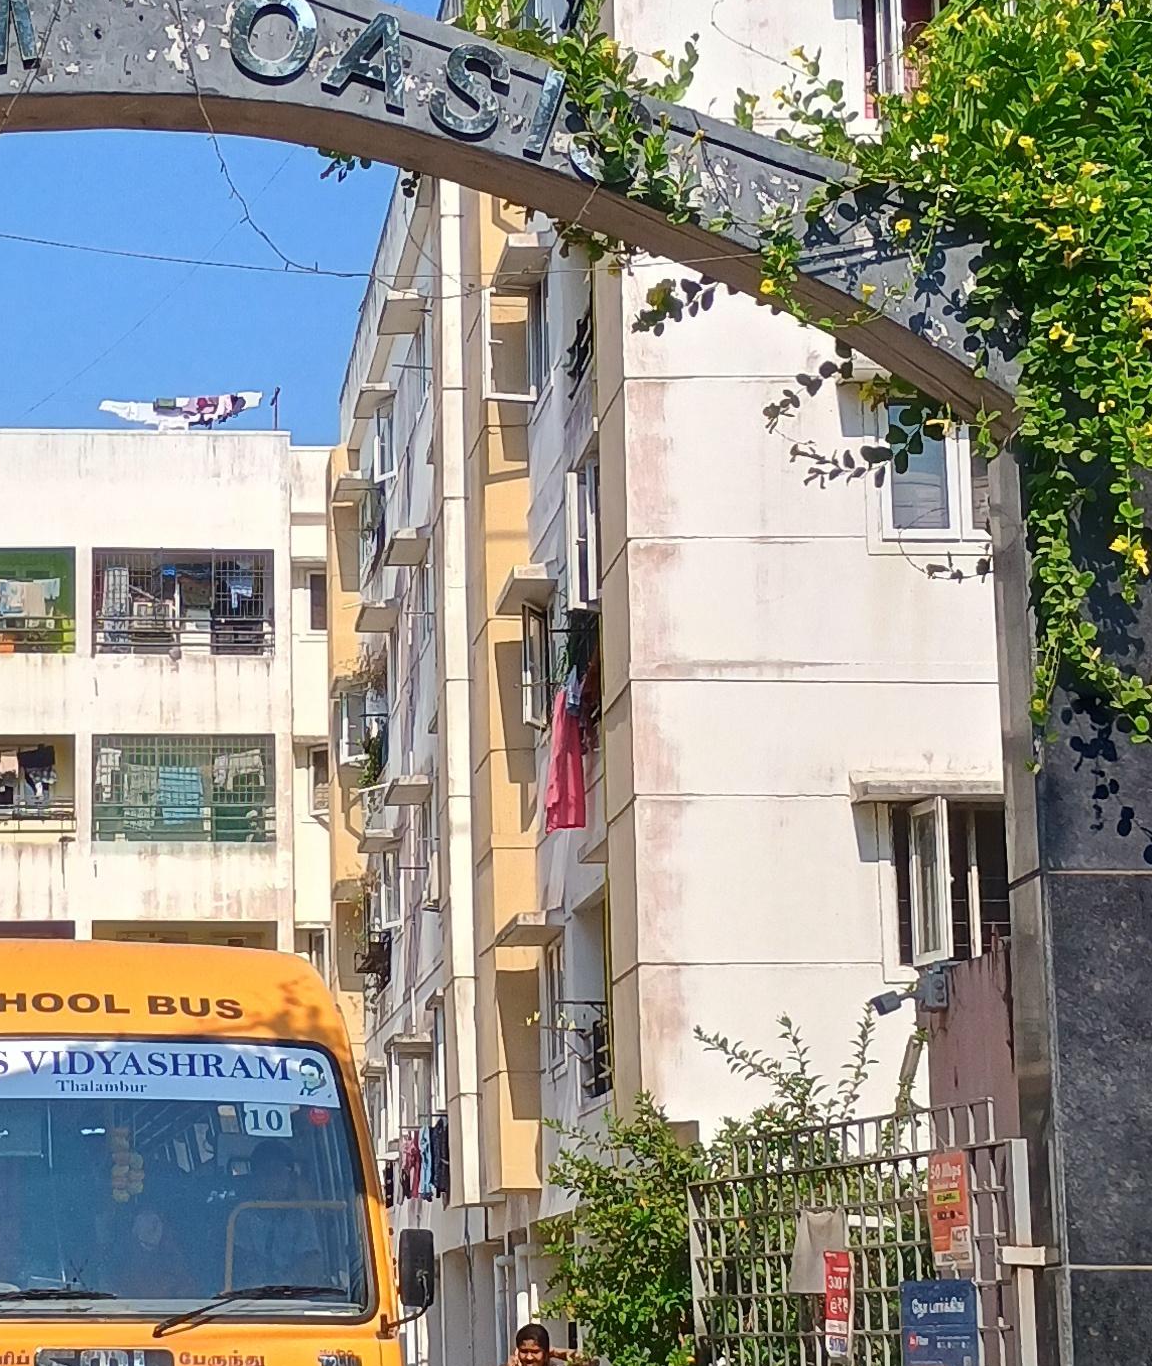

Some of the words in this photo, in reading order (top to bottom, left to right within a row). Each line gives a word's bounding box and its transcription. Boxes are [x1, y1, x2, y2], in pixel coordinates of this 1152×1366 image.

[147, 995, 244, 1020] BUS
[22, 1050, 292, 1081] VIDYASHRAM
[55, 1079, 148, 1093] Thalambur
[248, 1108, 283, 1131] 10
